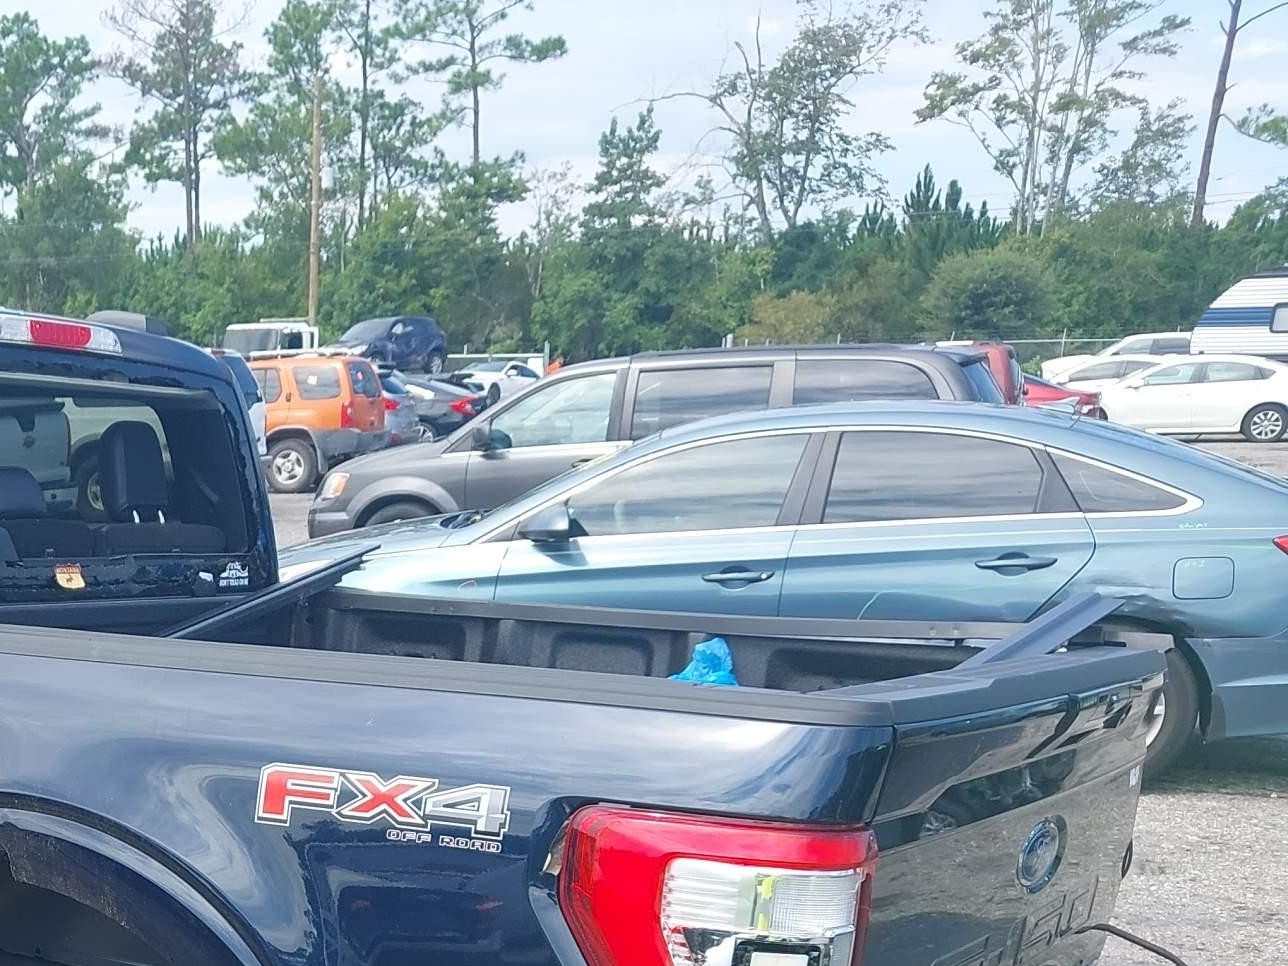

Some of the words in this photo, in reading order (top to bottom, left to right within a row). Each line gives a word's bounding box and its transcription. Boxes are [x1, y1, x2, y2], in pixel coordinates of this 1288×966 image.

[254, 762, 512, 841] FX4
[386, 829, 432, 845] OFF
[439, 835, 502, 853] ROAD
